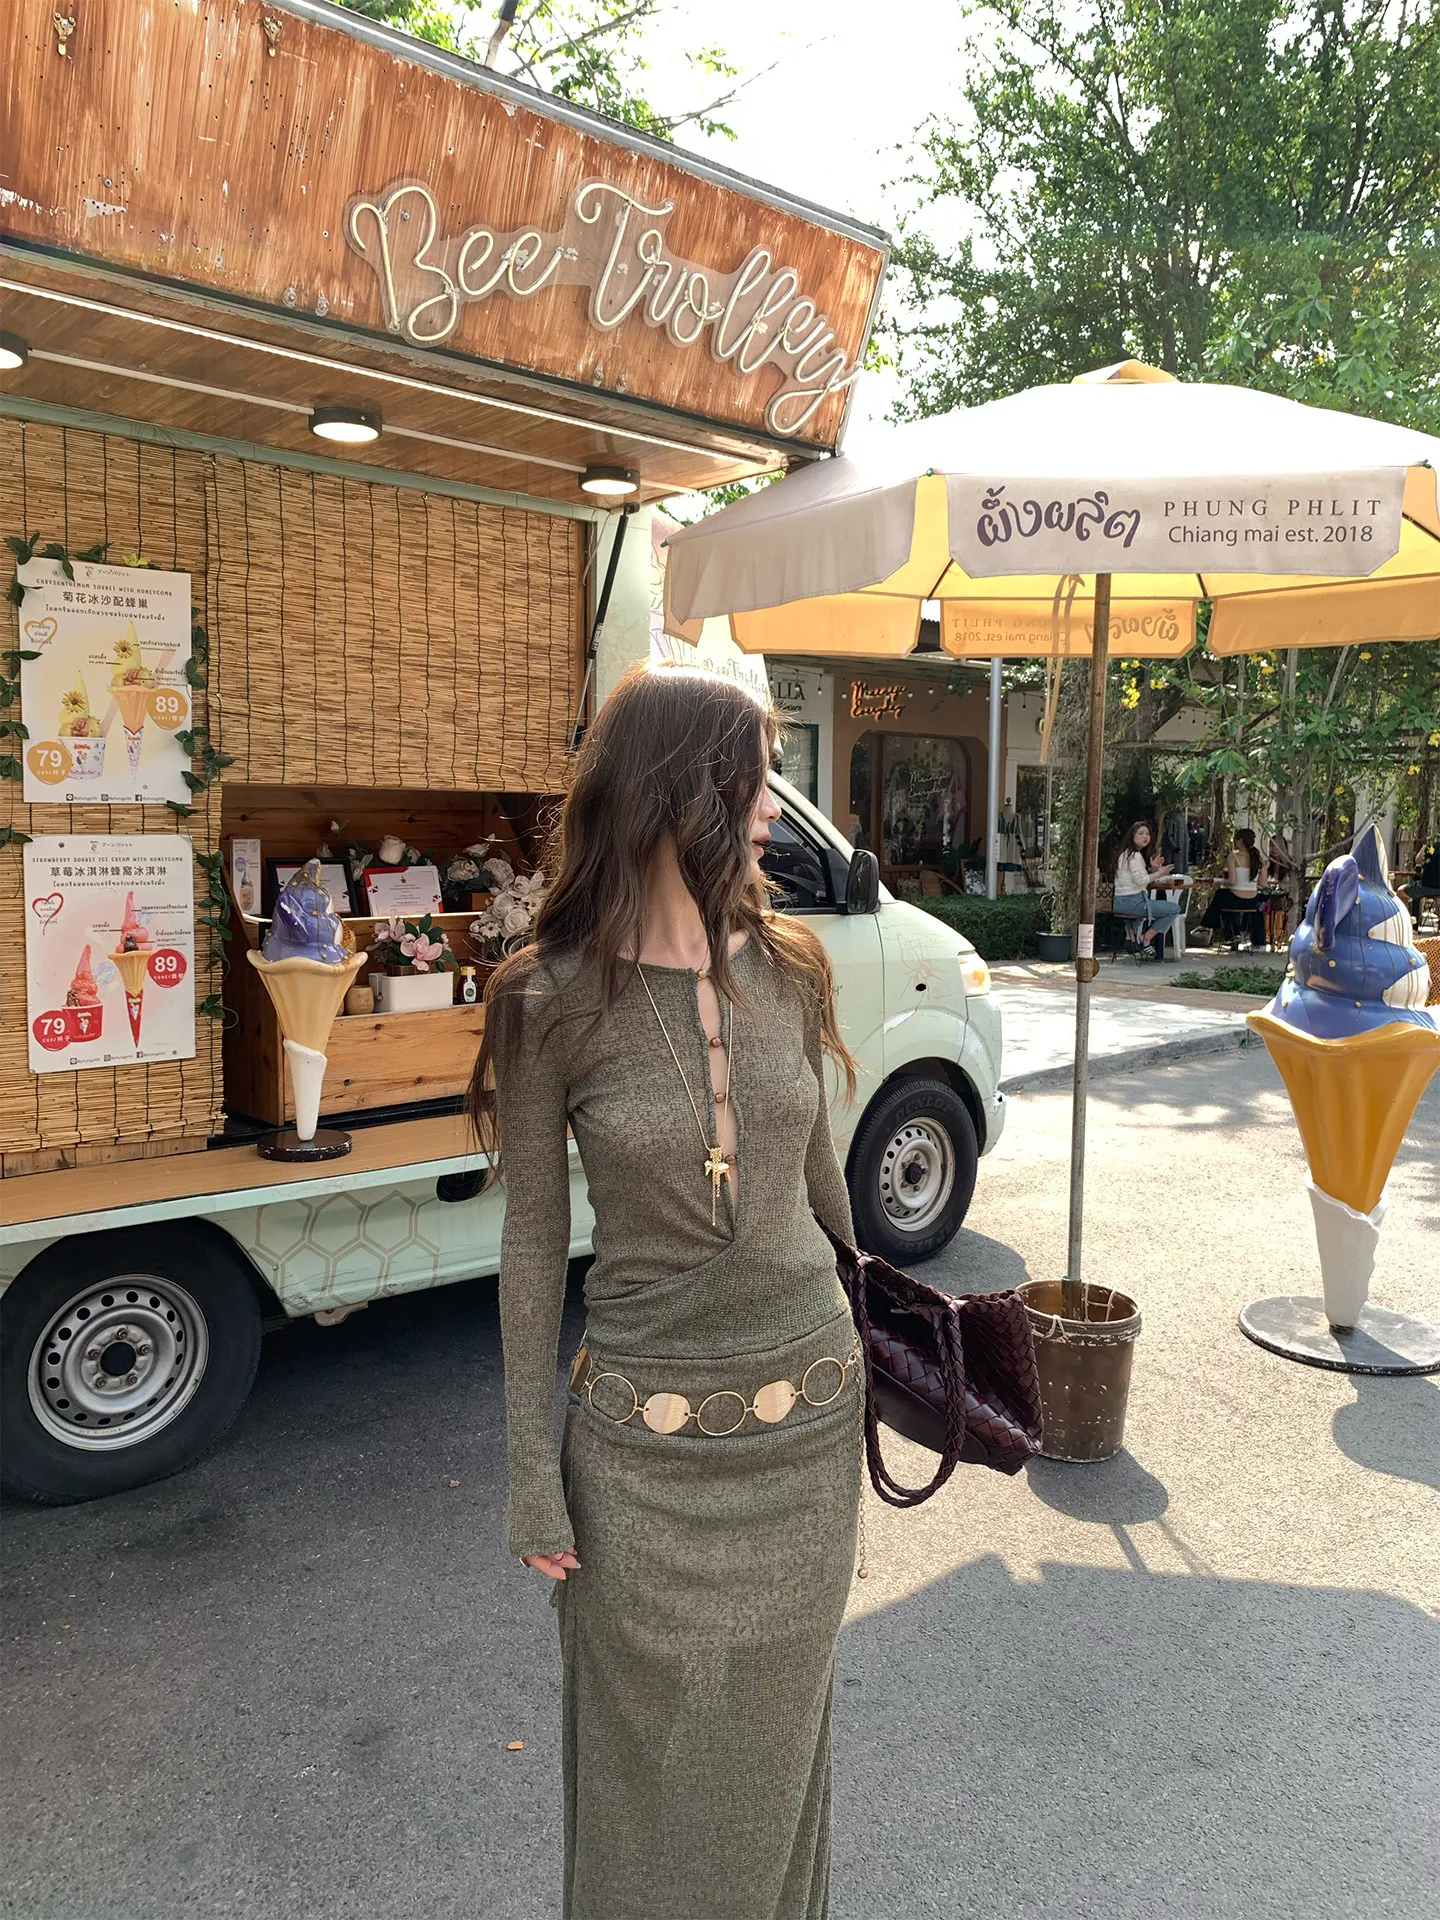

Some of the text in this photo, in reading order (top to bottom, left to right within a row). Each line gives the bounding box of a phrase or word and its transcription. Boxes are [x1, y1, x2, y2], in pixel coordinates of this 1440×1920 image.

[350, 183, 864, 435] Bee Trolley
[977, 485, 1141, 548] ผึ้งผลิต
[1164, 499, 1382, 518] PHUNG PHLIT
[1168, 525, 1373, 547] Chiang mai est. 2018
[62, 590, 149, 609] 菊花冰沙配蜂巢
[155, 696, 179, 713] 89
[36, 749, 62, 768] 79
[155, 956, 177, 973] 89
[40, 1018, 65, 1036] 79
[895, 1095, 957, 1122] DUNLOP
